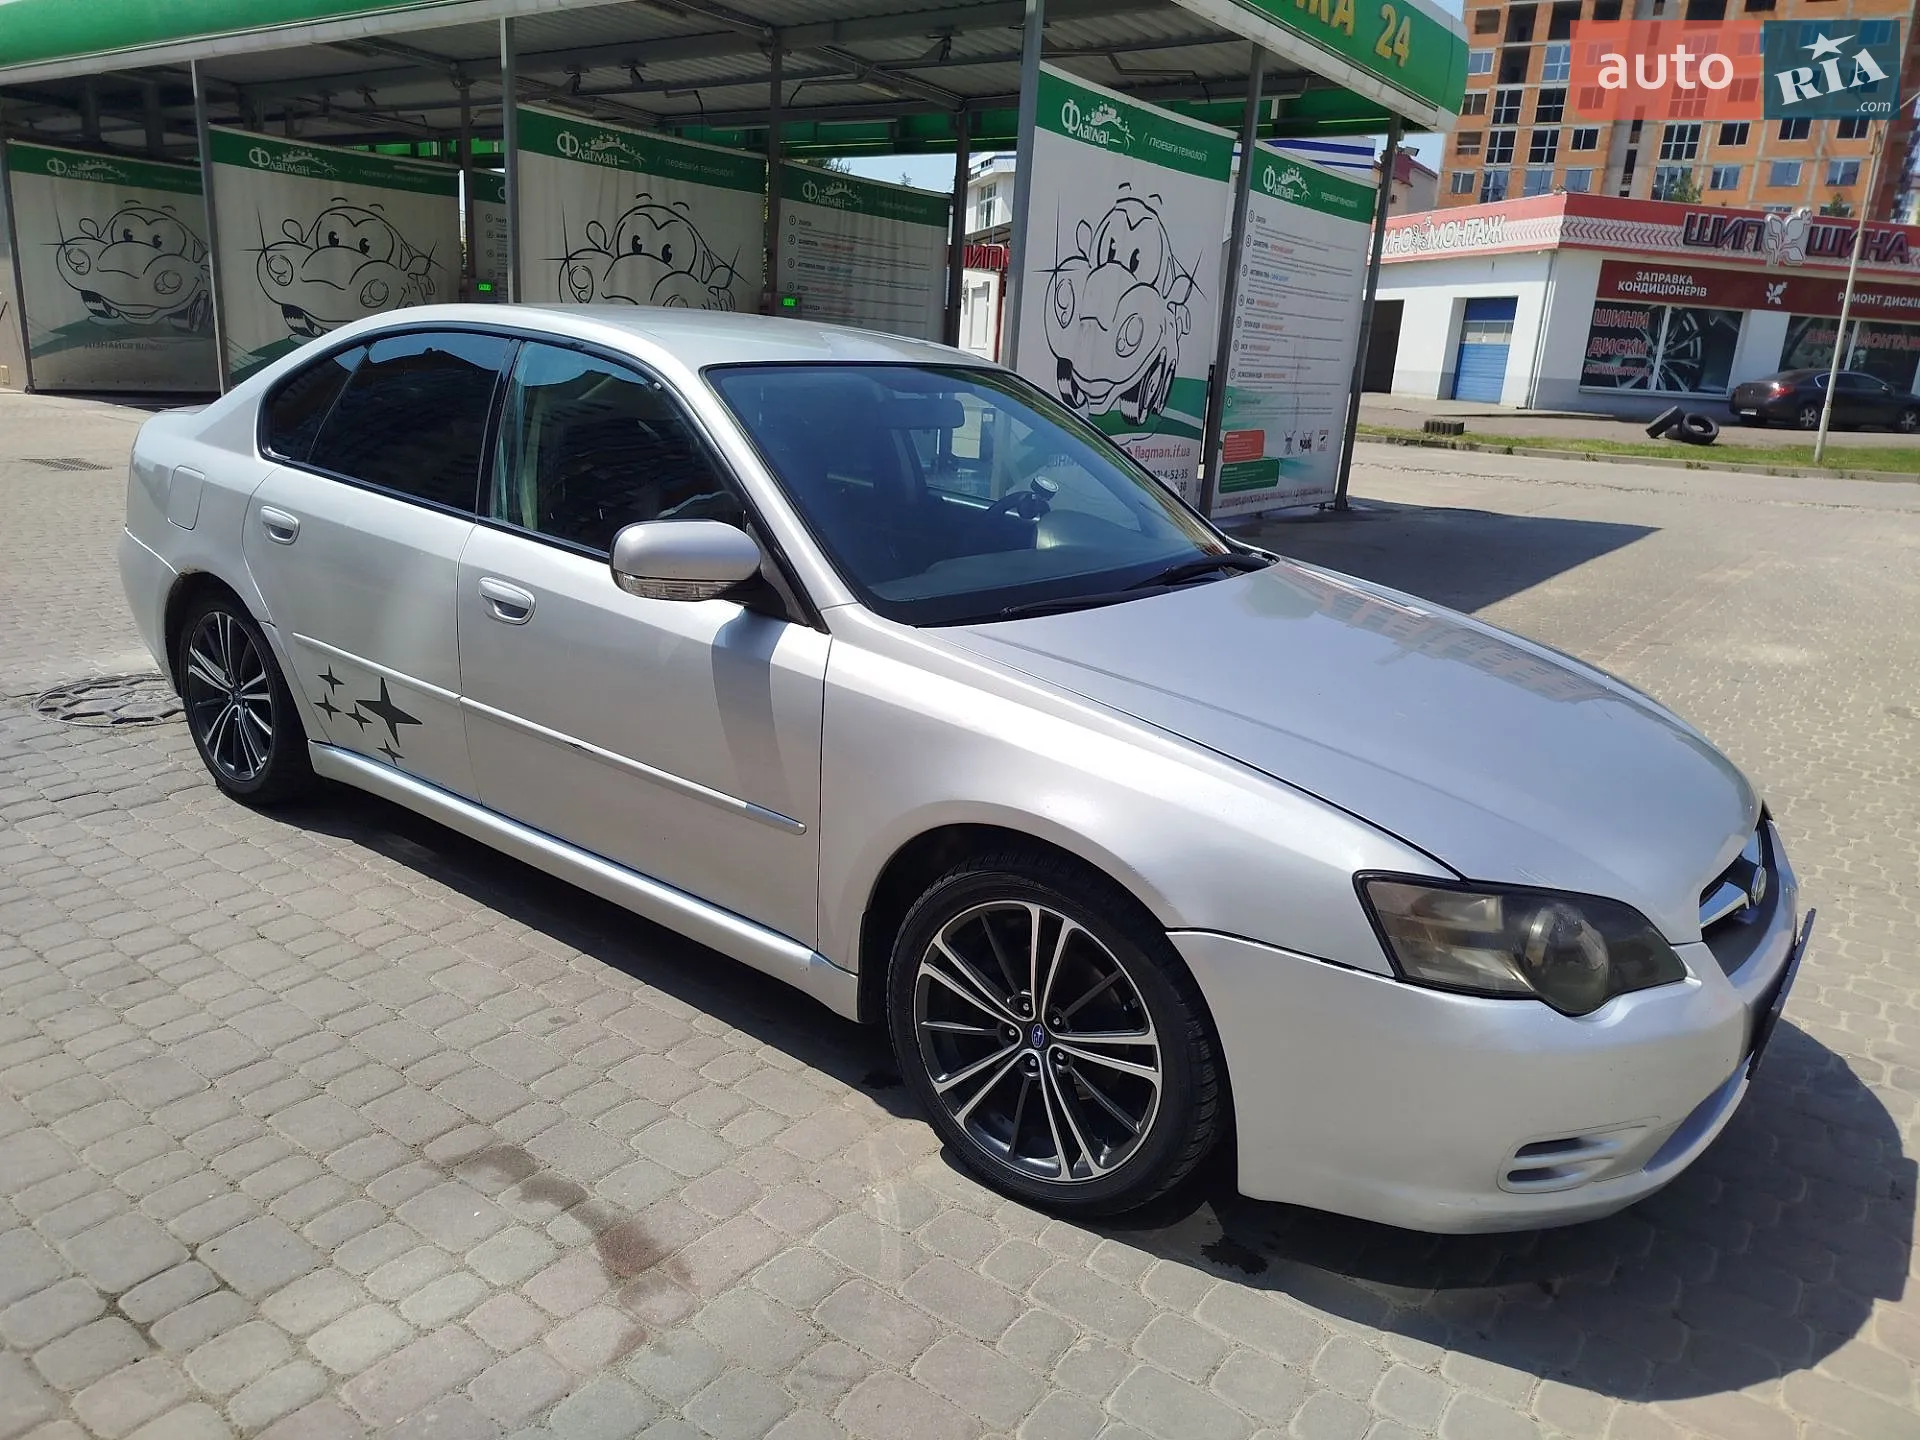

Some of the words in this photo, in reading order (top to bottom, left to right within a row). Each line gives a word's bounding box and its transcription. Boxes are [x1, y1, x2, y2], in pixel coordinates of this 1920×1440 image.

[1375, 3, 1411, 68] 24
[556, 130, 618, 166] Флагман
[249, 147, 310, 176] Флагман
[1683, 212, 1766, 251] ШИП
[1805, 224, 1911, 264] ШИНА
[1617, 281, 1707, 297] КОНДИЦІОНЕРІВ
[1636, 272, 1694, 285] ЗАПРАВКА
[1838, 292, 1882, 305] РМОНТ
[1593, 308, 1650, 329] ШИНИ
[1134, 444, 1191, 462] flagman.if.ua
